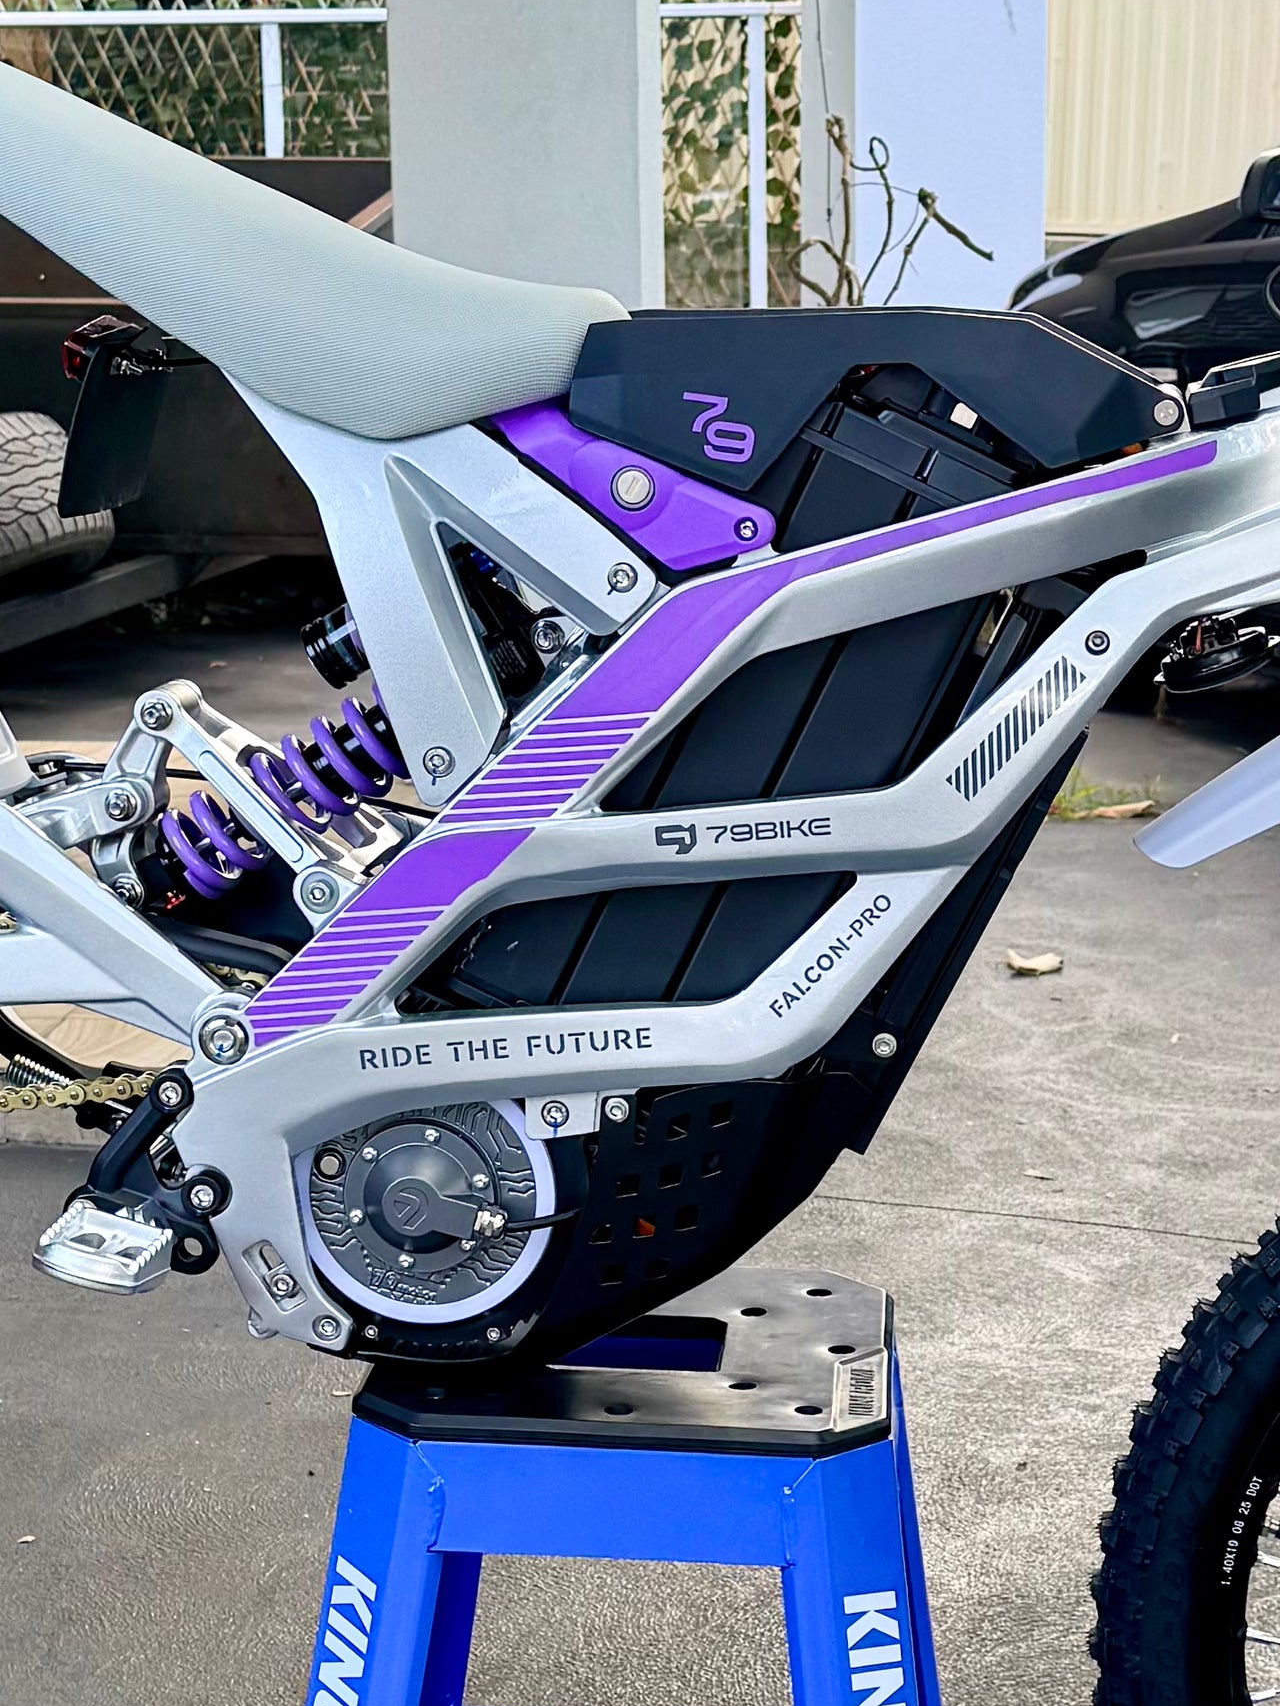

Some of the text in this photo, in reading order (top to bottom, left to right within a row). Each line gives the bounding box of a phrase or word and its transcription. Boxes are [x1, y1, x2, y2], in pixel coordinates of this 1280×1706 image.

[683, 392, 755, 463] 79
[706, 817, 832, 844] 79BIKE
[769, 894, 892, 1018] FALCON-PRO
[359, 1027, 652, 1070] RIDE THE FUTURE
[1238, 1501, 1252, 1515] 25
[1246, 1476, 1263, 1496] DOT
